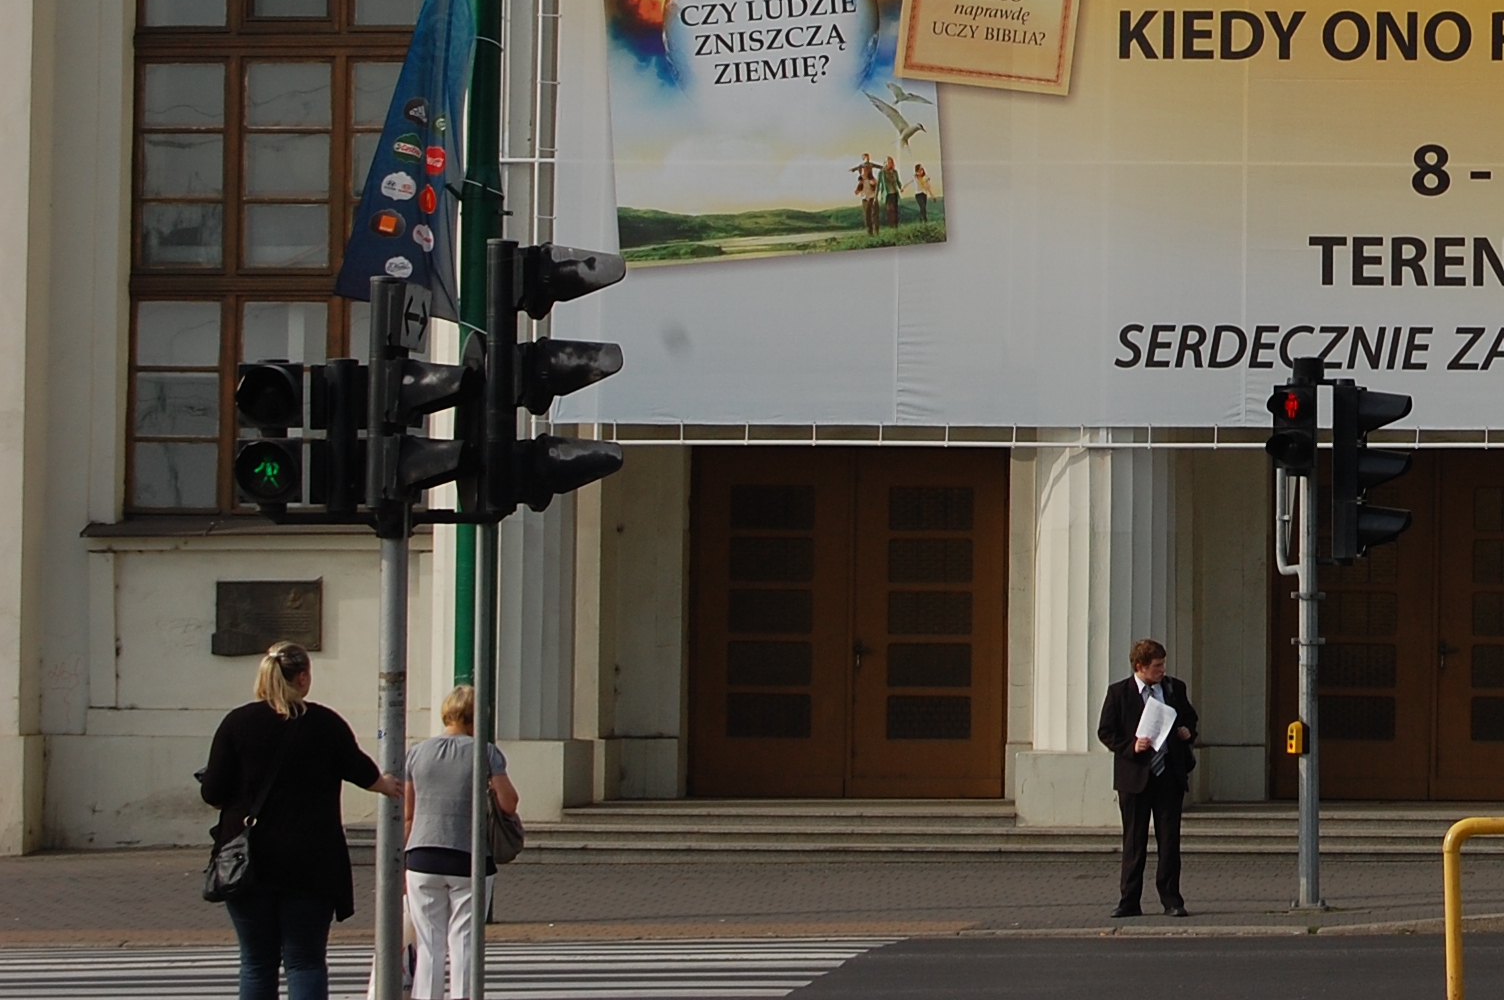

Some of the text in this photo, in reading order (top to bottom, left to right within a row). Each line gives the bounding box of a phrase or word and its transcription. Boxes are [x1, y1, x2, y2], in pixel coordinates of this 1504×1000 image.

[680, 2, 737, 27] CZY
[953, 3, 1030, 25] naprawdę
[695, 24, 846, 56] ZNISZCZĄ
[932, 20, 1046, 46] UCZY BIBLIA?
[1119, 10, 1307, 60] KIEDY
[1322, 10, 1472, 62] ONO
[714, 55, 830, 85] ZIEMIĘ?
[1411, 144, 1451, 197] 8
[1470, 171, 1492, 180] -
[1114, 324, 1434, 372] SERDECZNIE
